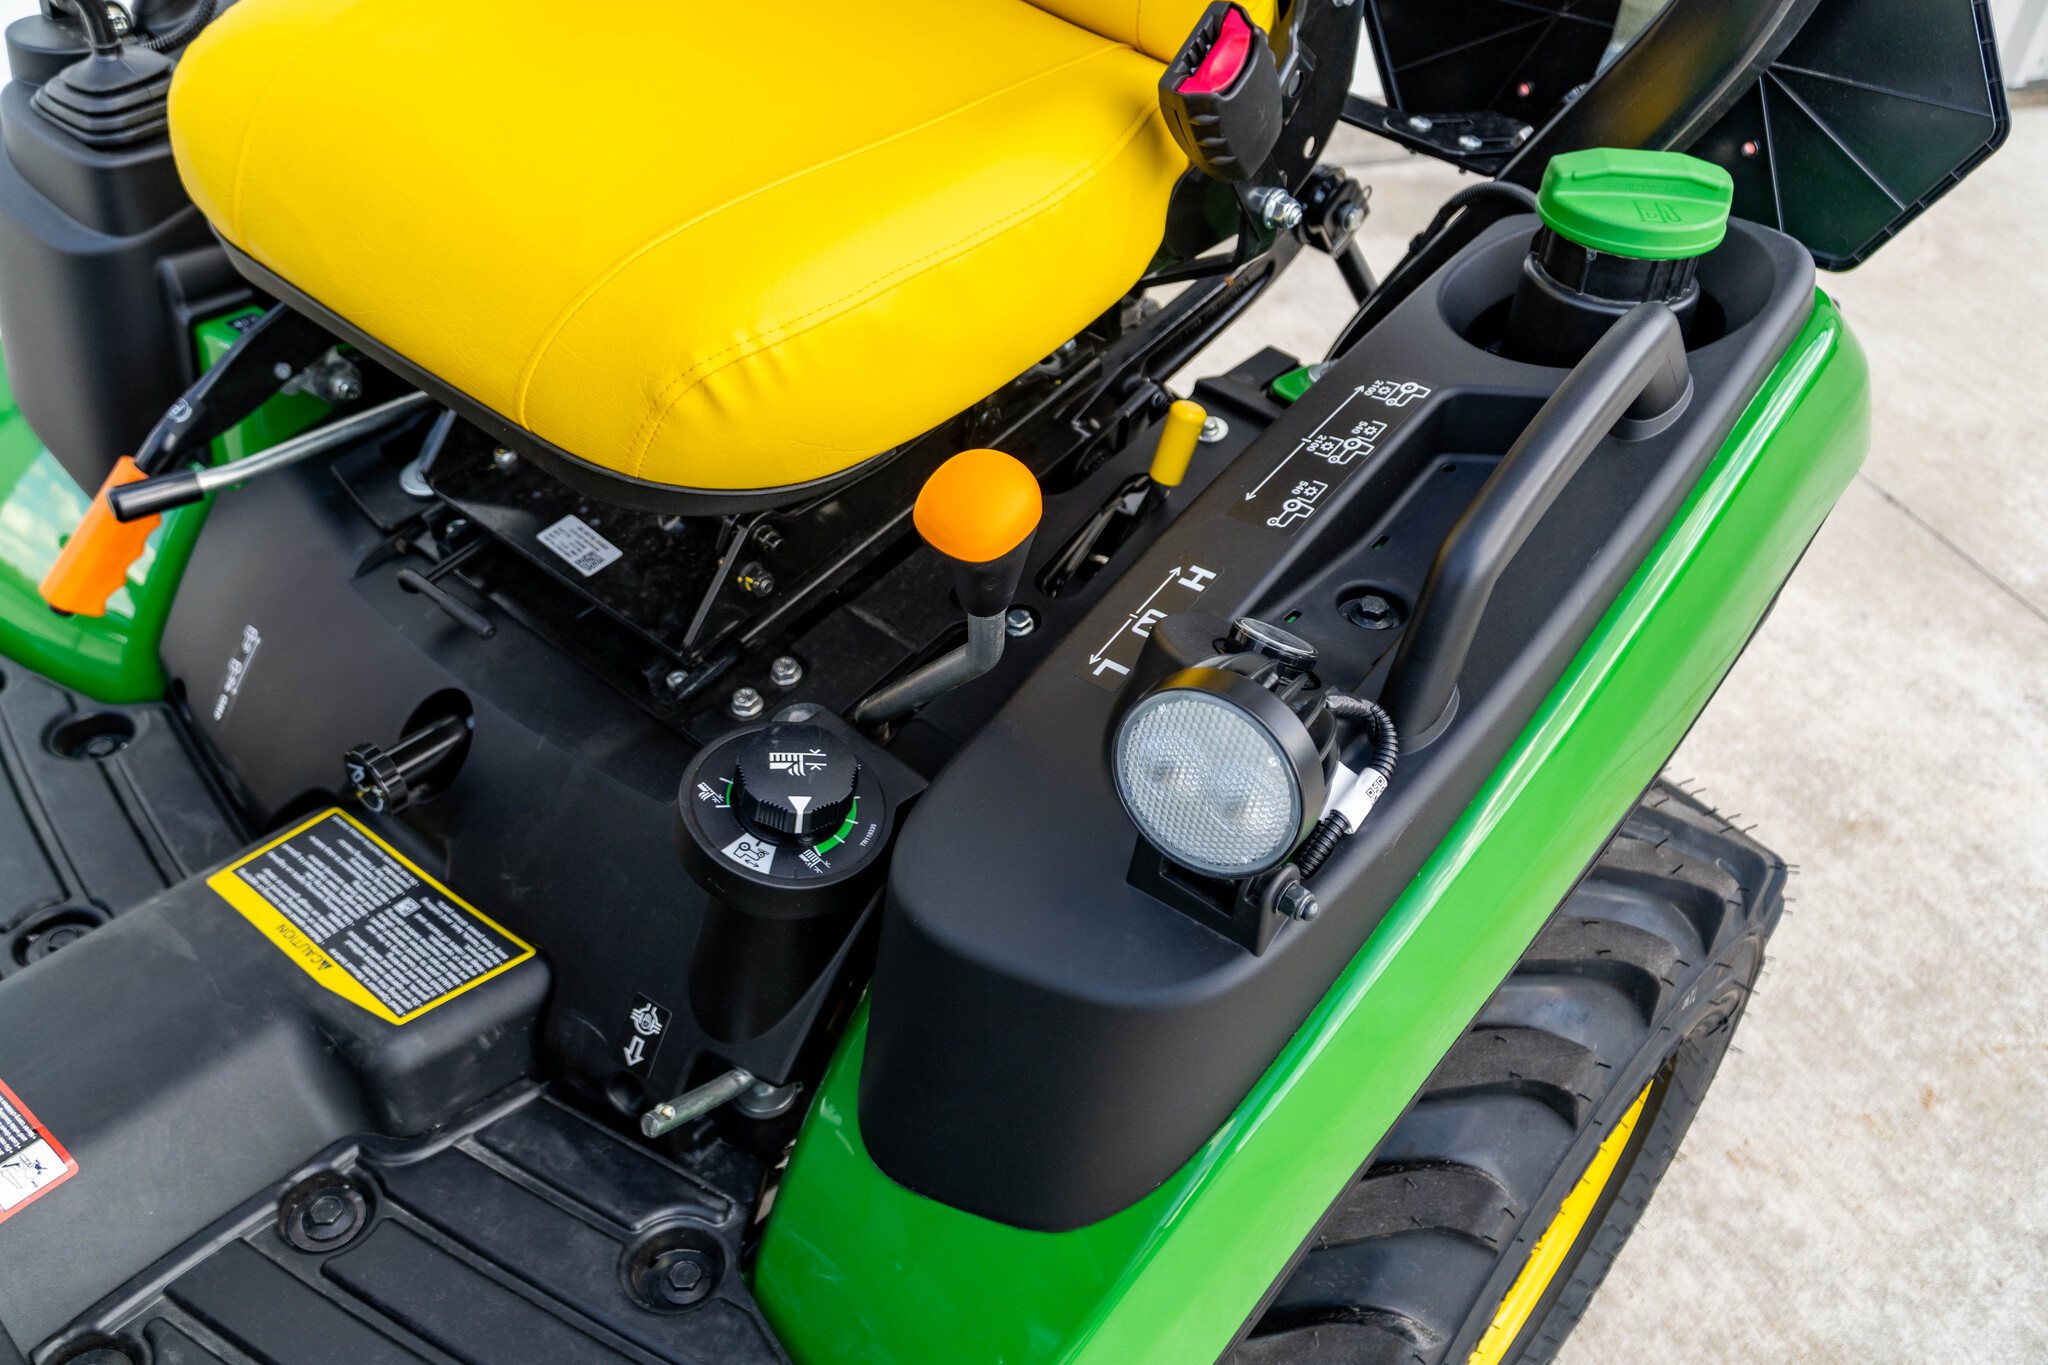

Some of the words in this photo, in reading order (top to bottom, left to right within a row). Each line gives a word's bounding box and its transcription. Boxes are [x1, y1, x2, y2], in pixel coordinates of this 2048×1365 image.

[1364, 379, 1384, 396] 2100
[1351, 420, 1369, 435] 540
[1306, 434, 1327, 452] 2100
[1291, 480, 1309, 495] 540
[1177, 564, 1217, 592] H
[1092, 658, 1130, 676] L
[276, 923, 325, 964] CAUTION
